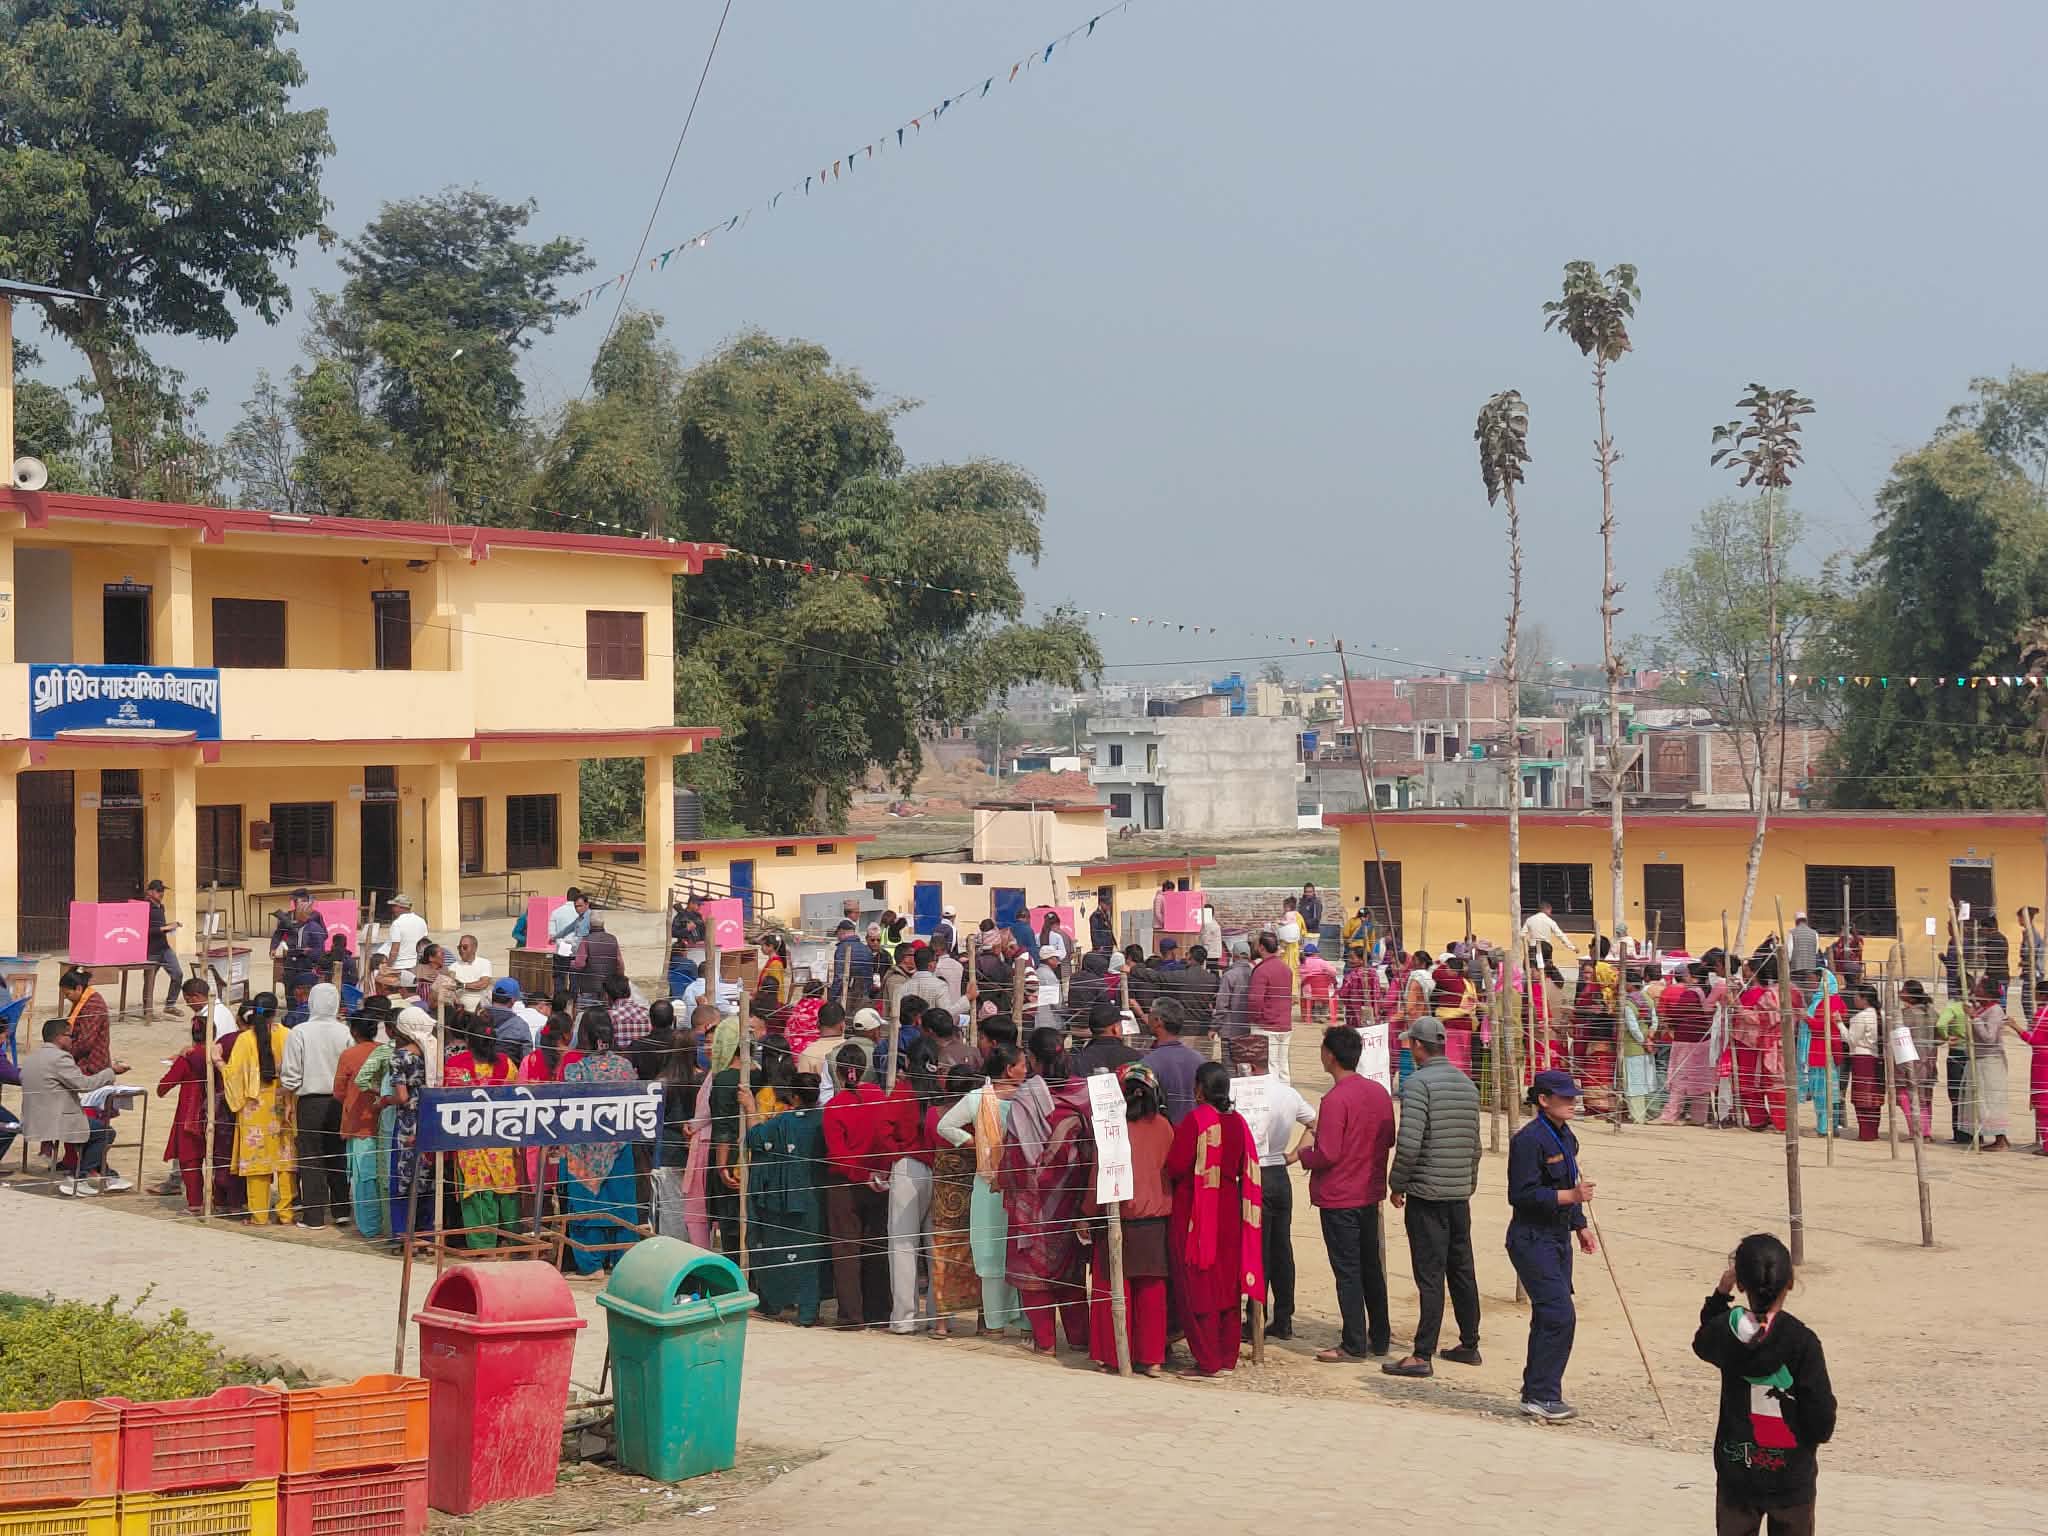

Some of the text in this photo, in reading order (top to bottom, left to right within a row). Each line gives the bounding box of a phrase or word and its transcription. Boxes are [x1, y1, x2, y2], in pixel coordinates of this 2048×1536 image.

[34, 668, 218, 714] श्री शिव माध्यमिक विद्यालय
